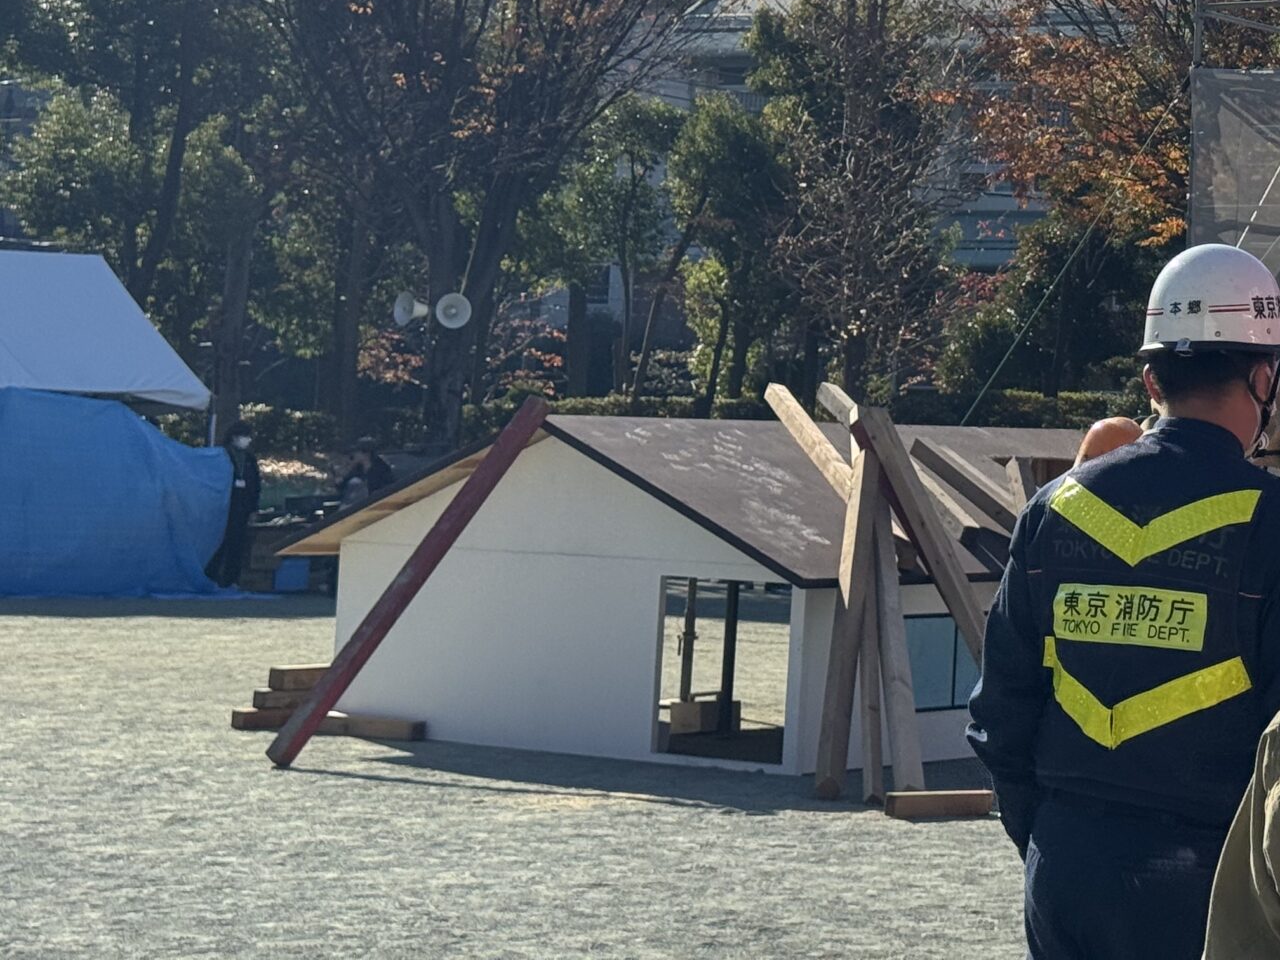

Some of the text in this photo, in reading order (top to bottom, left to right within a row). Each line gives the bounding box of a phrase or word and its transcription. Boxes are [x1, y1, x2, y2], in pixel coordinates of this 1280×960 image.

[1063, 591, 1195, 625] 東京消防庁
[1062, 619, 1101, 635] TOKYO
[1147, 624, 1190, 644] DEPT.
